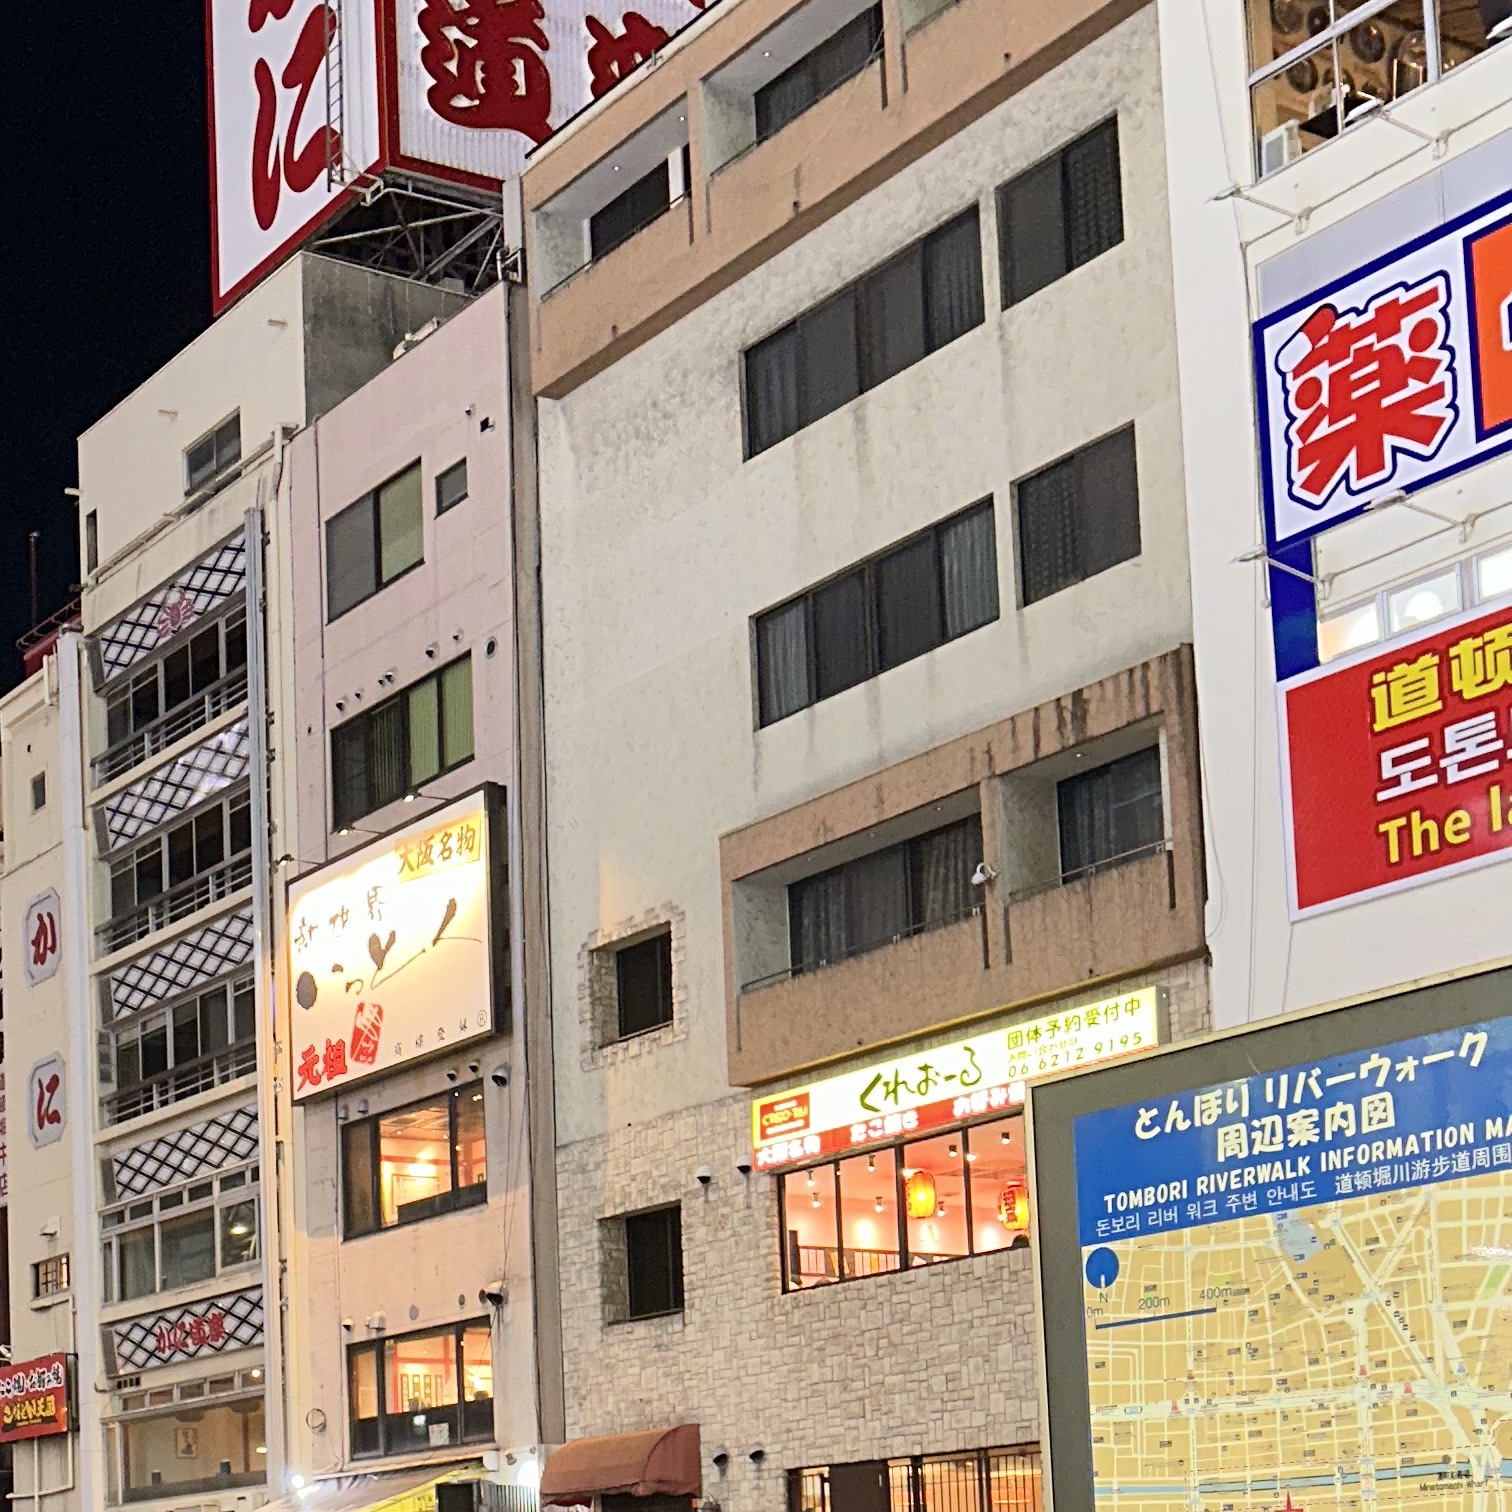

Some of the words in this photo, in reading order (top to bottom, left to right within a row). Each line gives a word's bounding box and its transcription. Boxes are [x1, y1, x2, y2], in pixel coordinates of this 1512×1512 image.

[249, 0, 342, 231] に
[1278, 284, 1448, 499] 薬
[396, 823, 478, 876] 大阪名物
[1378, 807, 1471, 864] The
[1489, 784, 1512, 833] l
[1006, 996, 1142, 1051] 団体予約受付中
[296, 1037, 349, 1093] 元祖
[858, 1046, 983, 1113] くれおーる
[1007, 1061, 1029, 1078] 06
[1038, 1046, 1085, 1070] 6212
[1094, 1032, 1143, 1056] 9195
[1265, 1030, 1488, 1111] リバーウォーク
[1216, 1091, 1397, 1163] 周辺案内図
[1103, 1178, 1189, 1214] TOMBORI
[1196, 1155, 1312, 1197] RIVERWALK
[1320, 1121, 1475, 1174] INFORMATION
[1095, 1211, 1141, 1238] 돈보리
[1147, 1205, 1179, 1228] 리버
[1186, 1199, 1218, 1221] 워크
[1225, 1190, 1258, 1214] 주변
[1266, 1179, 1318, 1207] 안내도
[1137, 1295, 1171, 1311] 200m
[1198, 1286, 1233, 1301] 400m
[156, 1311, 226, 1355] かに道楽
